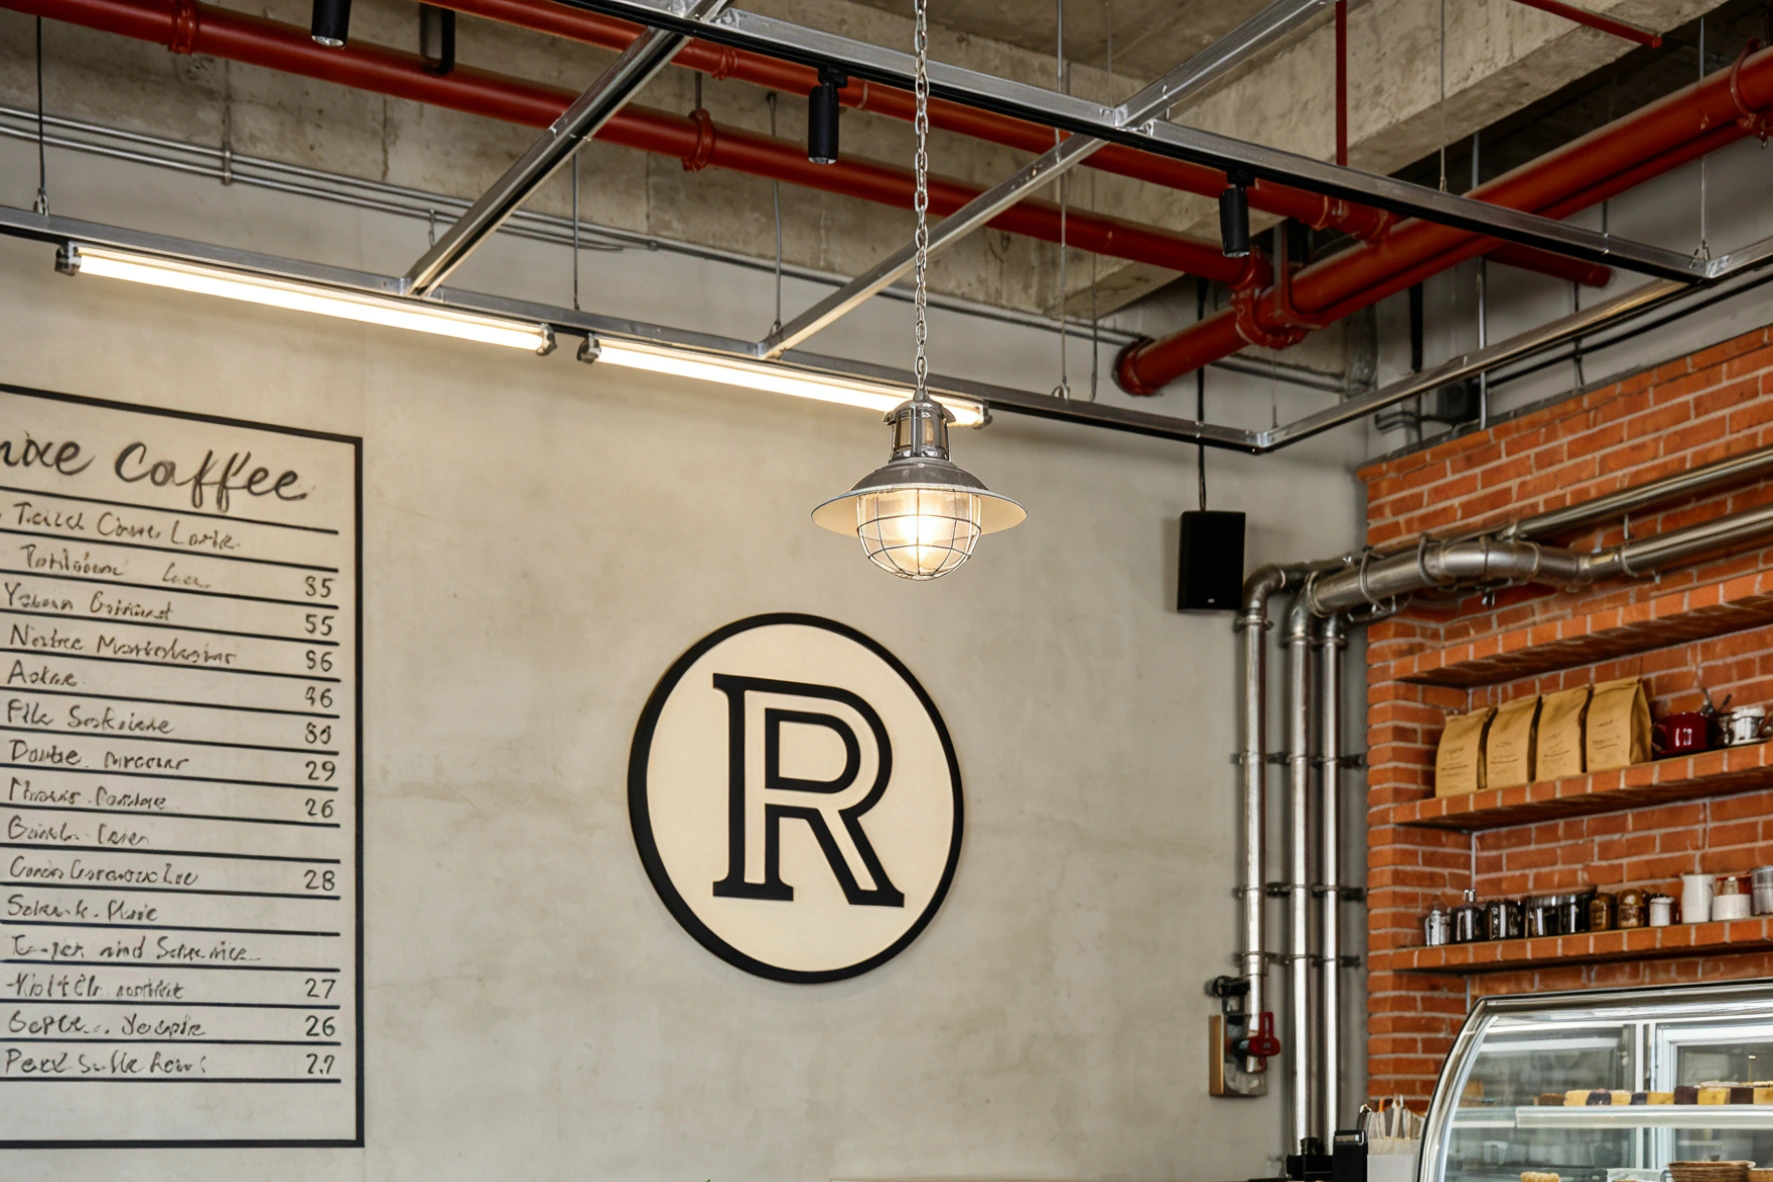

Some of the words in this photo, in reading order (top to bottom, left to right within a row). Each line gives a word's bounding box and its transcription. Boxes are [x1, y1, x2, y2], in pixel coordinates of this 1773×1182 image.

[305, 760, 336, 782] 29
[712, 673, 905, 908] R
[305, 797, 335, 819] 26
[304, 869, 335, 892] 28
[305, 978, 336, 1000] 27
[305, 1015, 335, 1038] 26
